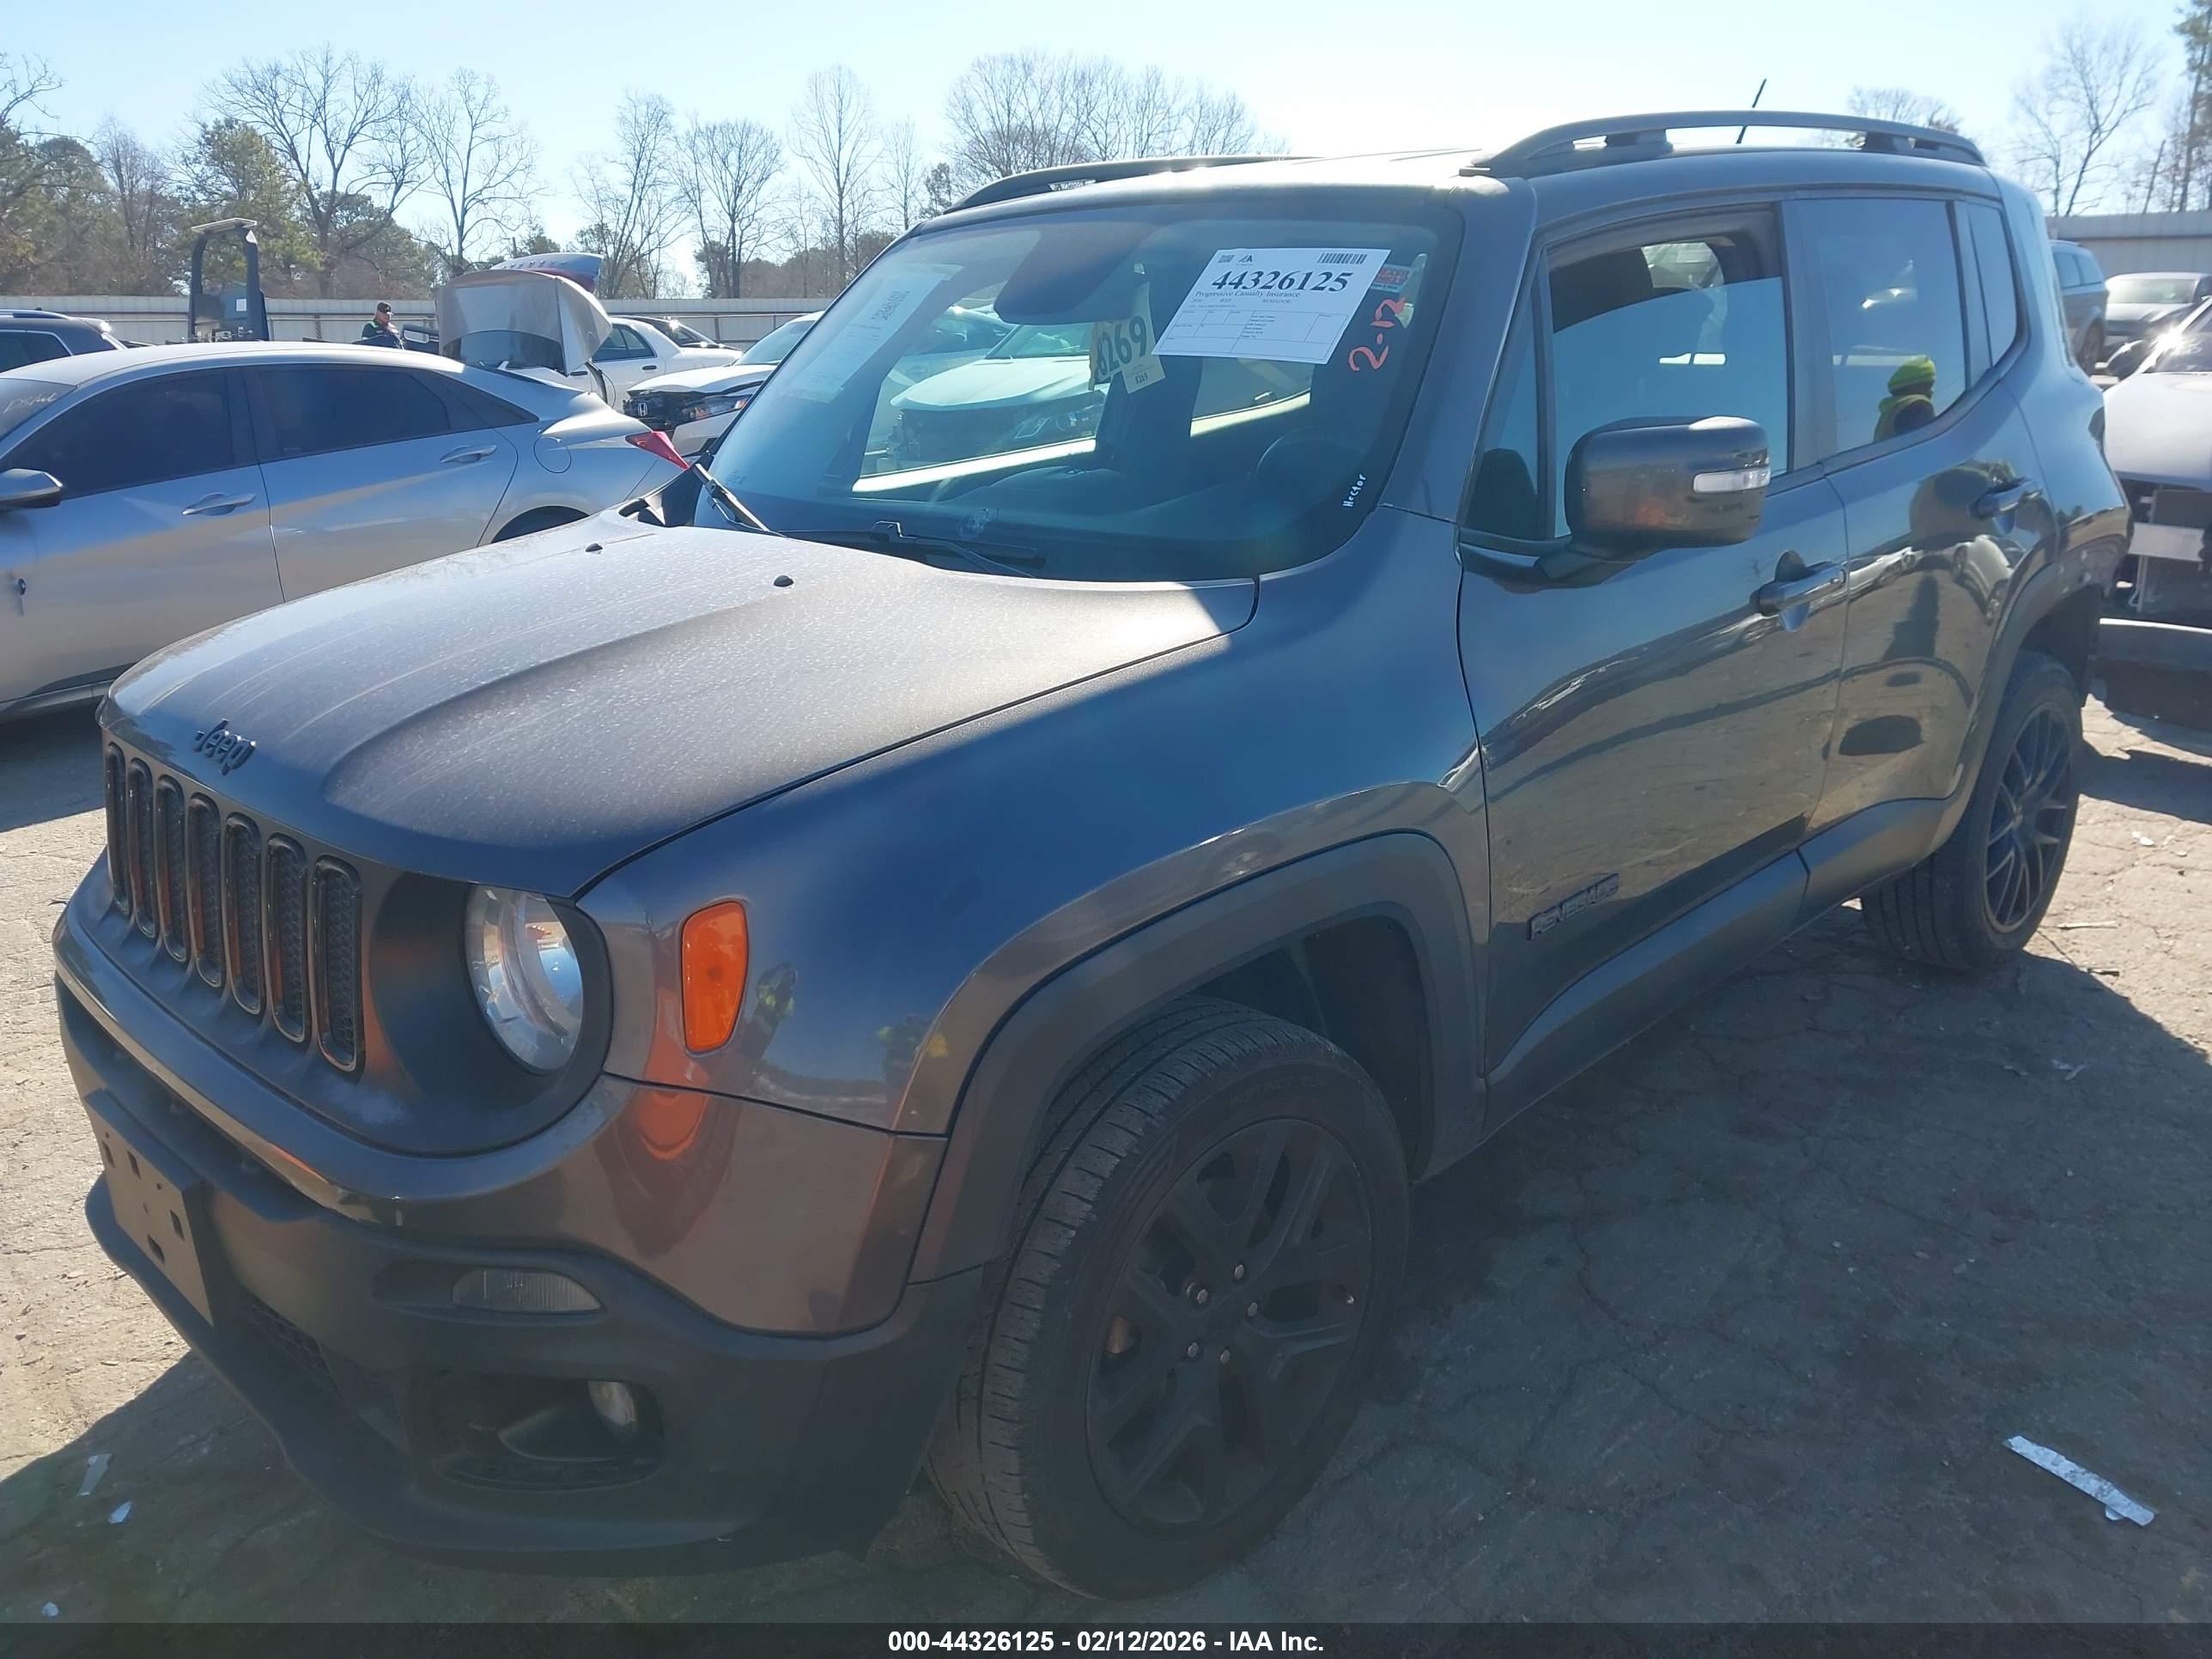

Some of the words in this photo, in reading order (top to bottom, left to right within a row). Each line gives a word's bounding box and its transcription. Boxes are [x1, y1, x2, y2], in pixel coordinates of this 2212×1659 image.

[1211, 270, 1354, 292] 44326125
[1097, 315, 1147, 376] 8269
[1348, 296, 1406, 371] 2-12
[1342, 473, 1367, 507] Hector
[192, 718, 256, 776] Jeep
